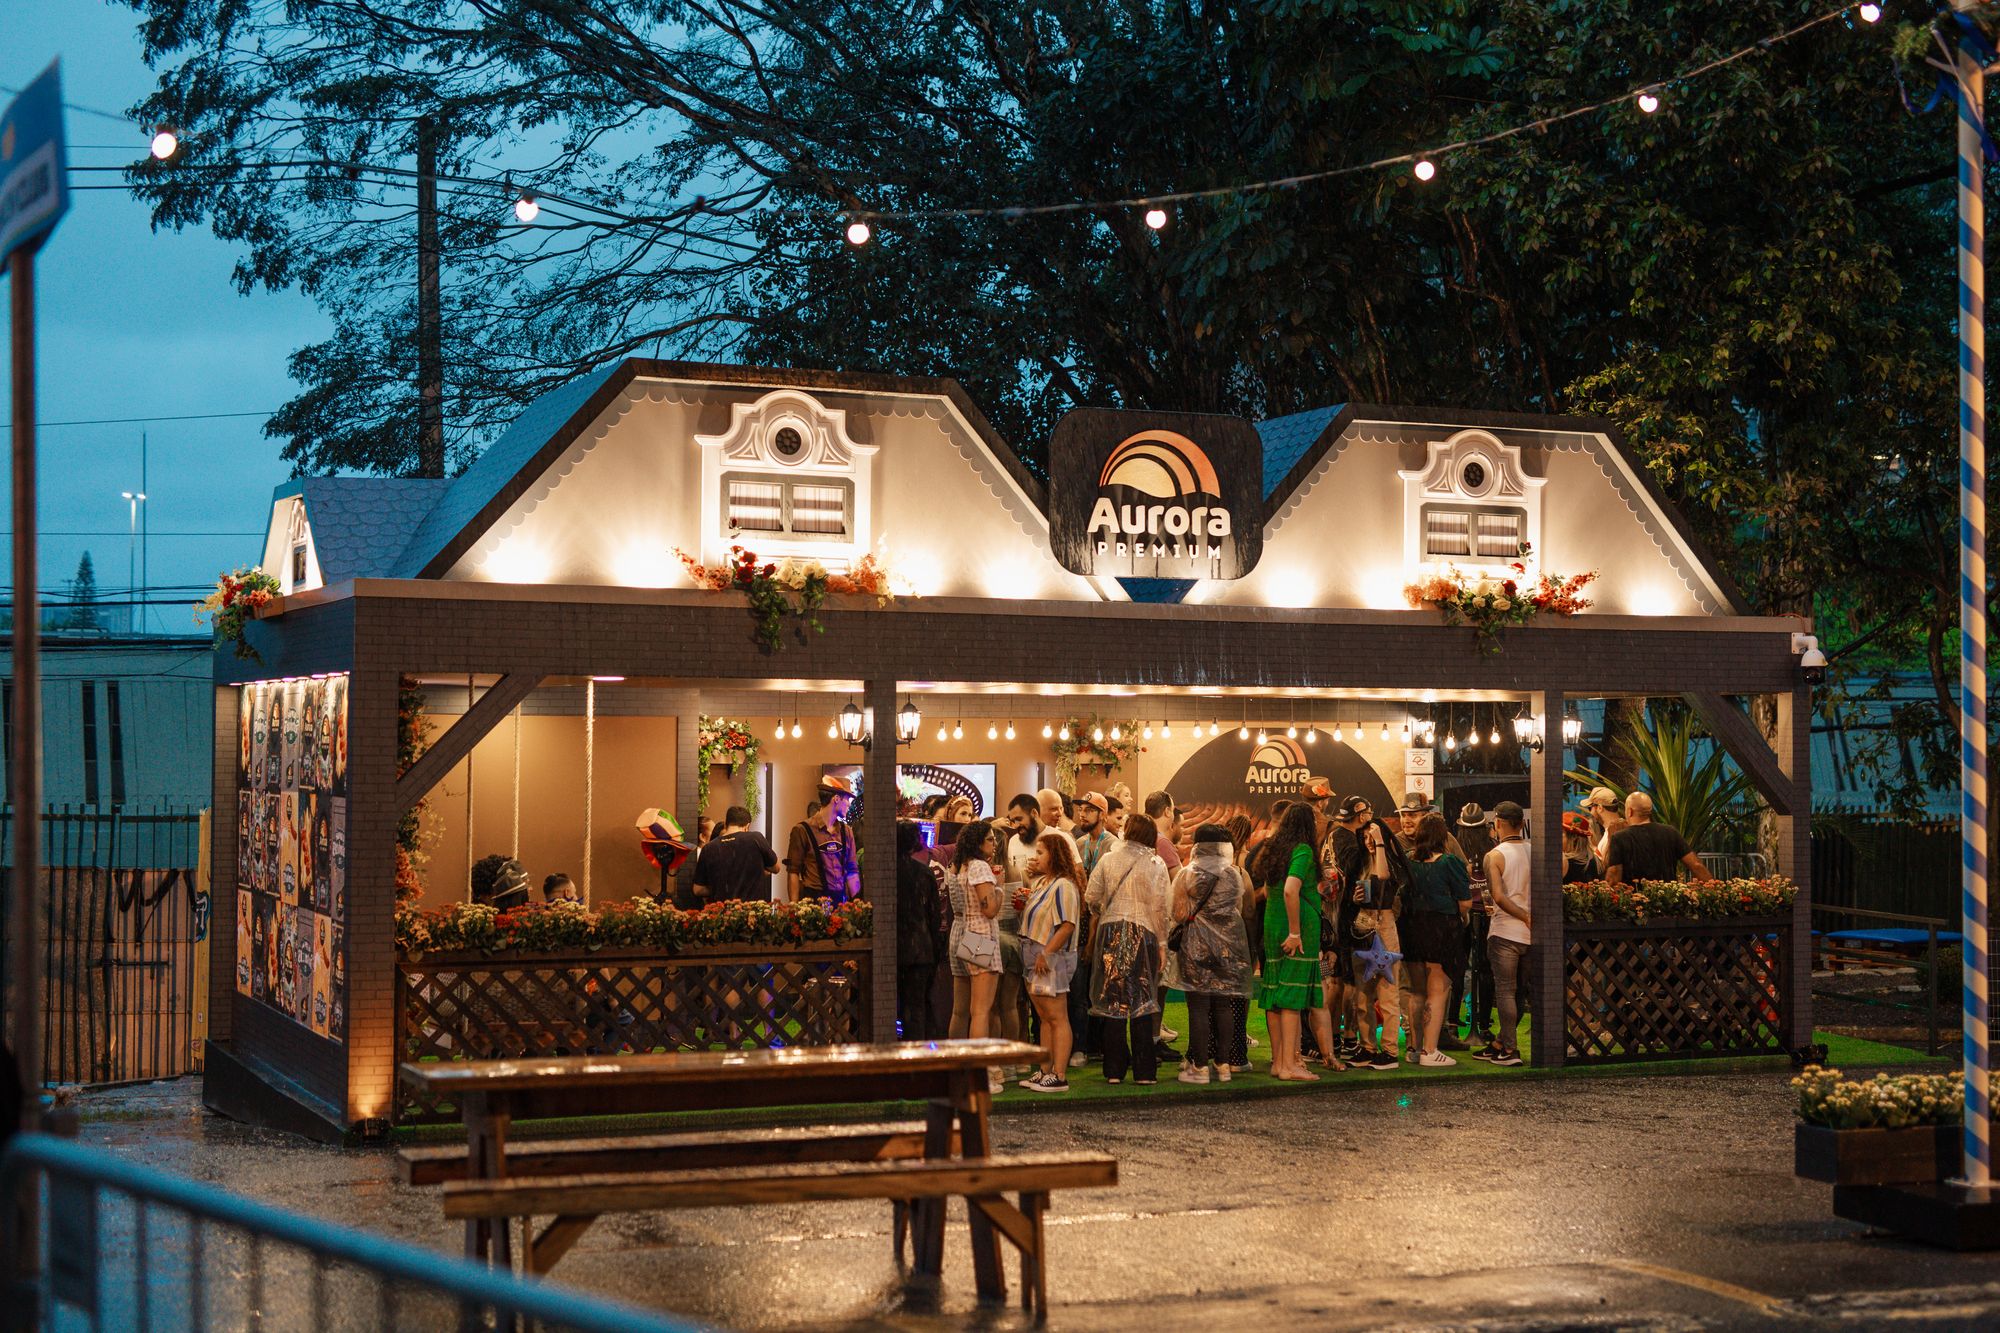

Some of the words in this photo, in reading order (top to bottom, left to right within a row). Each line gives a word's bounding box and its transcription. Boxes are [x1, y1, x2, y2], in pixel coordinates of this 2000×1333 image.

[1087, 497, 1231, 537] Aurora
[1097, 541, 1221, 560] PREMIUM
[1245, 765, 1311, 784] Aurora
[1249, 785, 1302, 794] PREMIU
